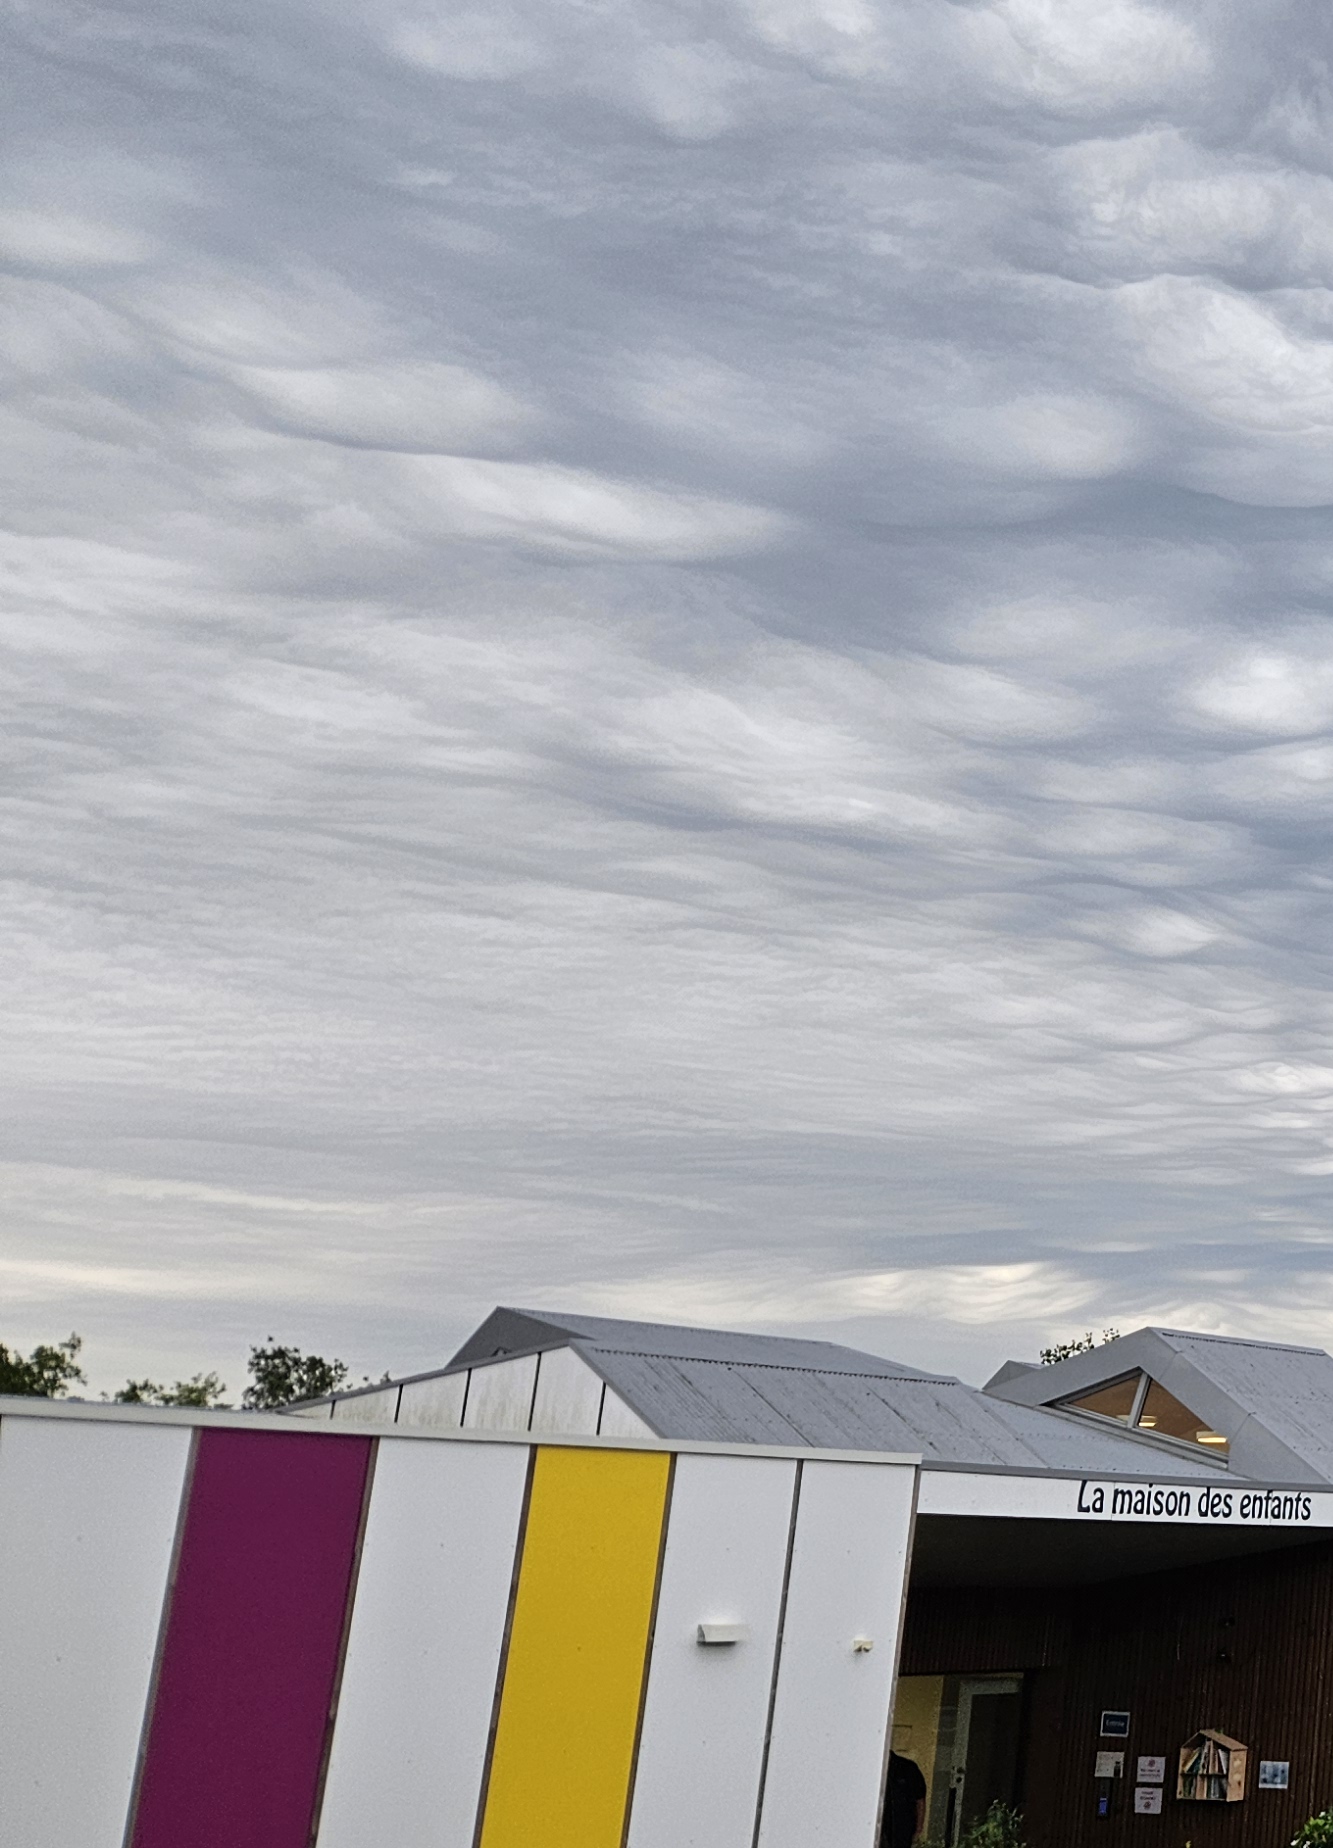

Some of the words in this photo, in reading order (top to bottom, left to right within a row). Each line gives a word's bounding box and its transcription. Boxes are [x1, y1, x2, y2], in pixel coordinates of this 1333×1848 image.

[1077, 1480, 1104, 1513] La
[1111, 1483, 1190, 1516] maison
[1197, 1487, 1233, 1518] des
[1239, 1489, 1312, 1521] enfants
